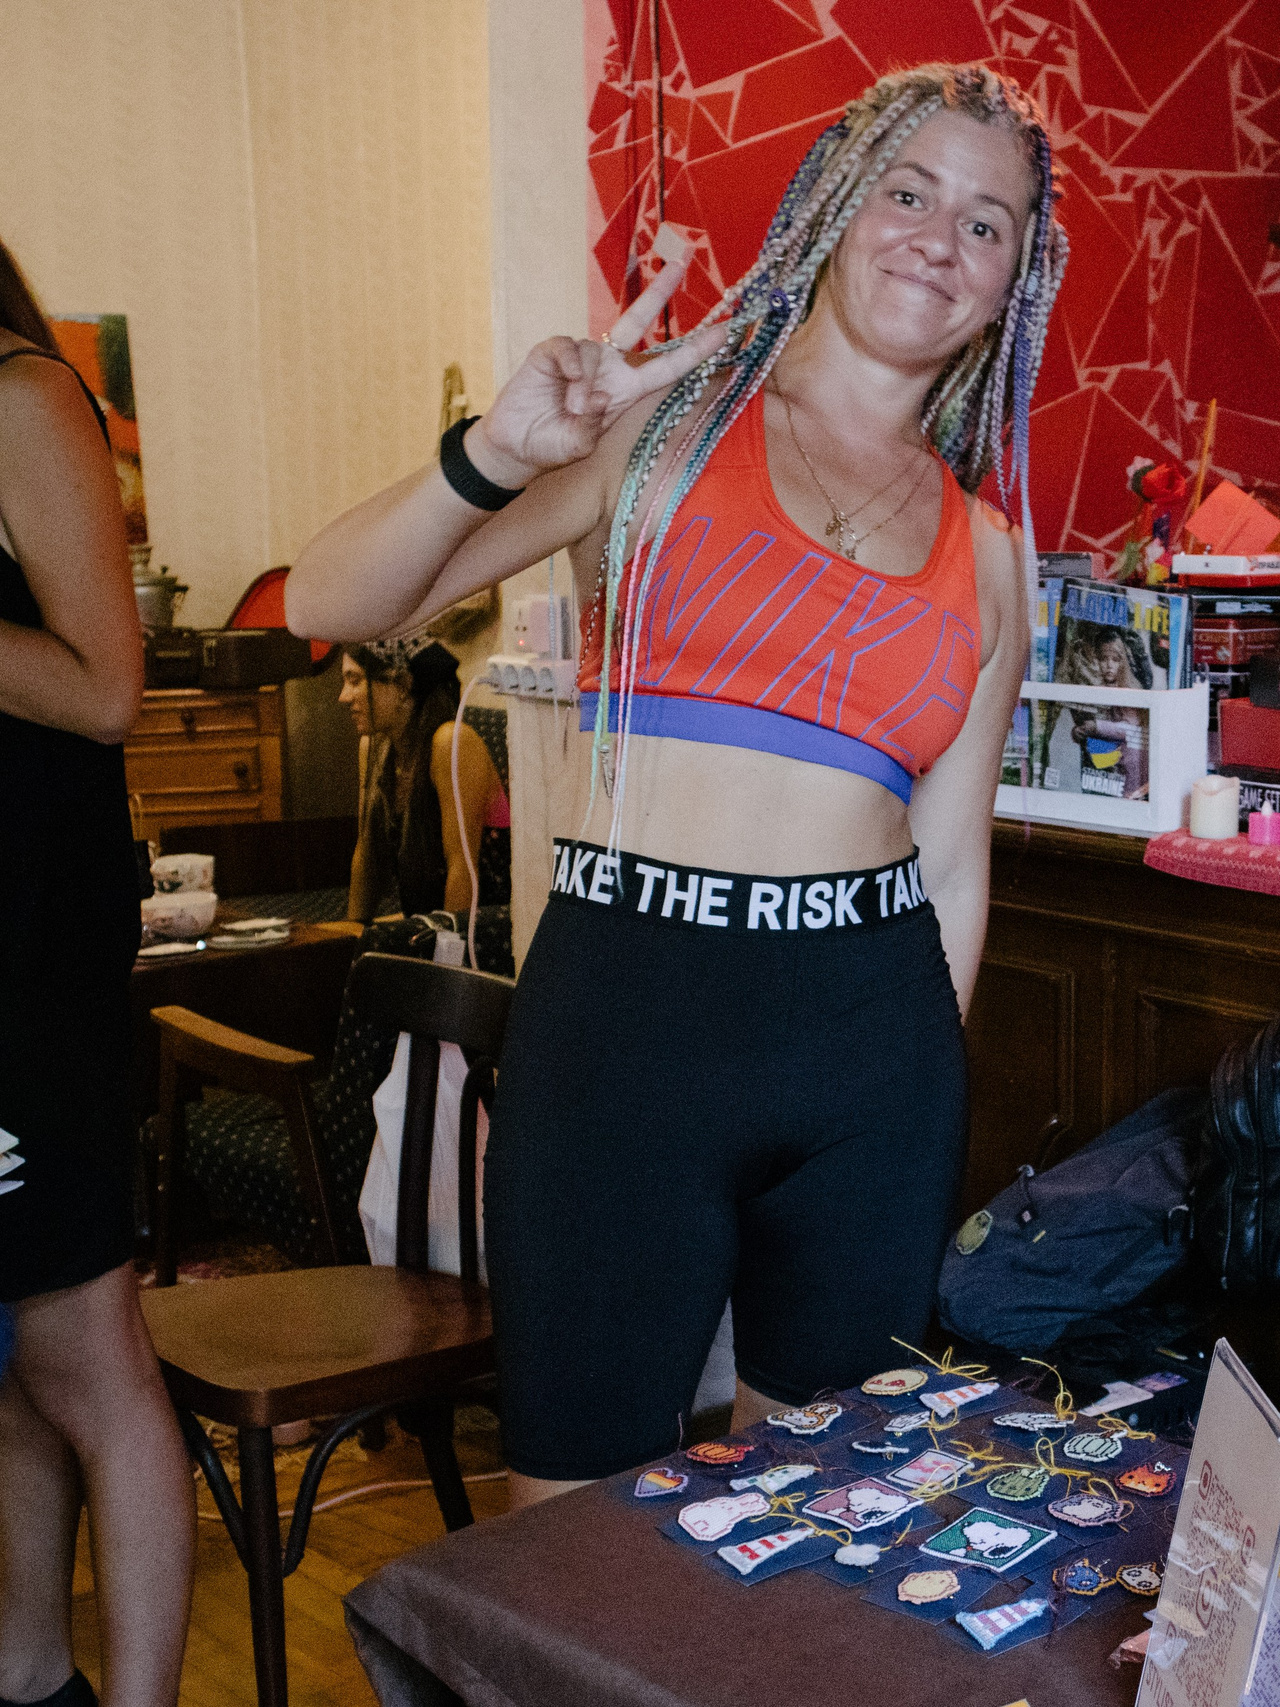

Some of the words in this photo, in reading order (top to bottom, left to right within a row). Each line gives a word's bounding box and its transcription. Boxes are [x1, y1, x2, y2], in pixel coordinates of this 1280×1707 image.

[599, 516, 976, 760] NIKE
[1082, 773, 1126, 797] UKRAINE
[551, 844, 622, 905] TAKE
[635, 863, 733, 926] THE
[747, 876, 866, 931] RISK
[875, 858, 928, 919] TAK
